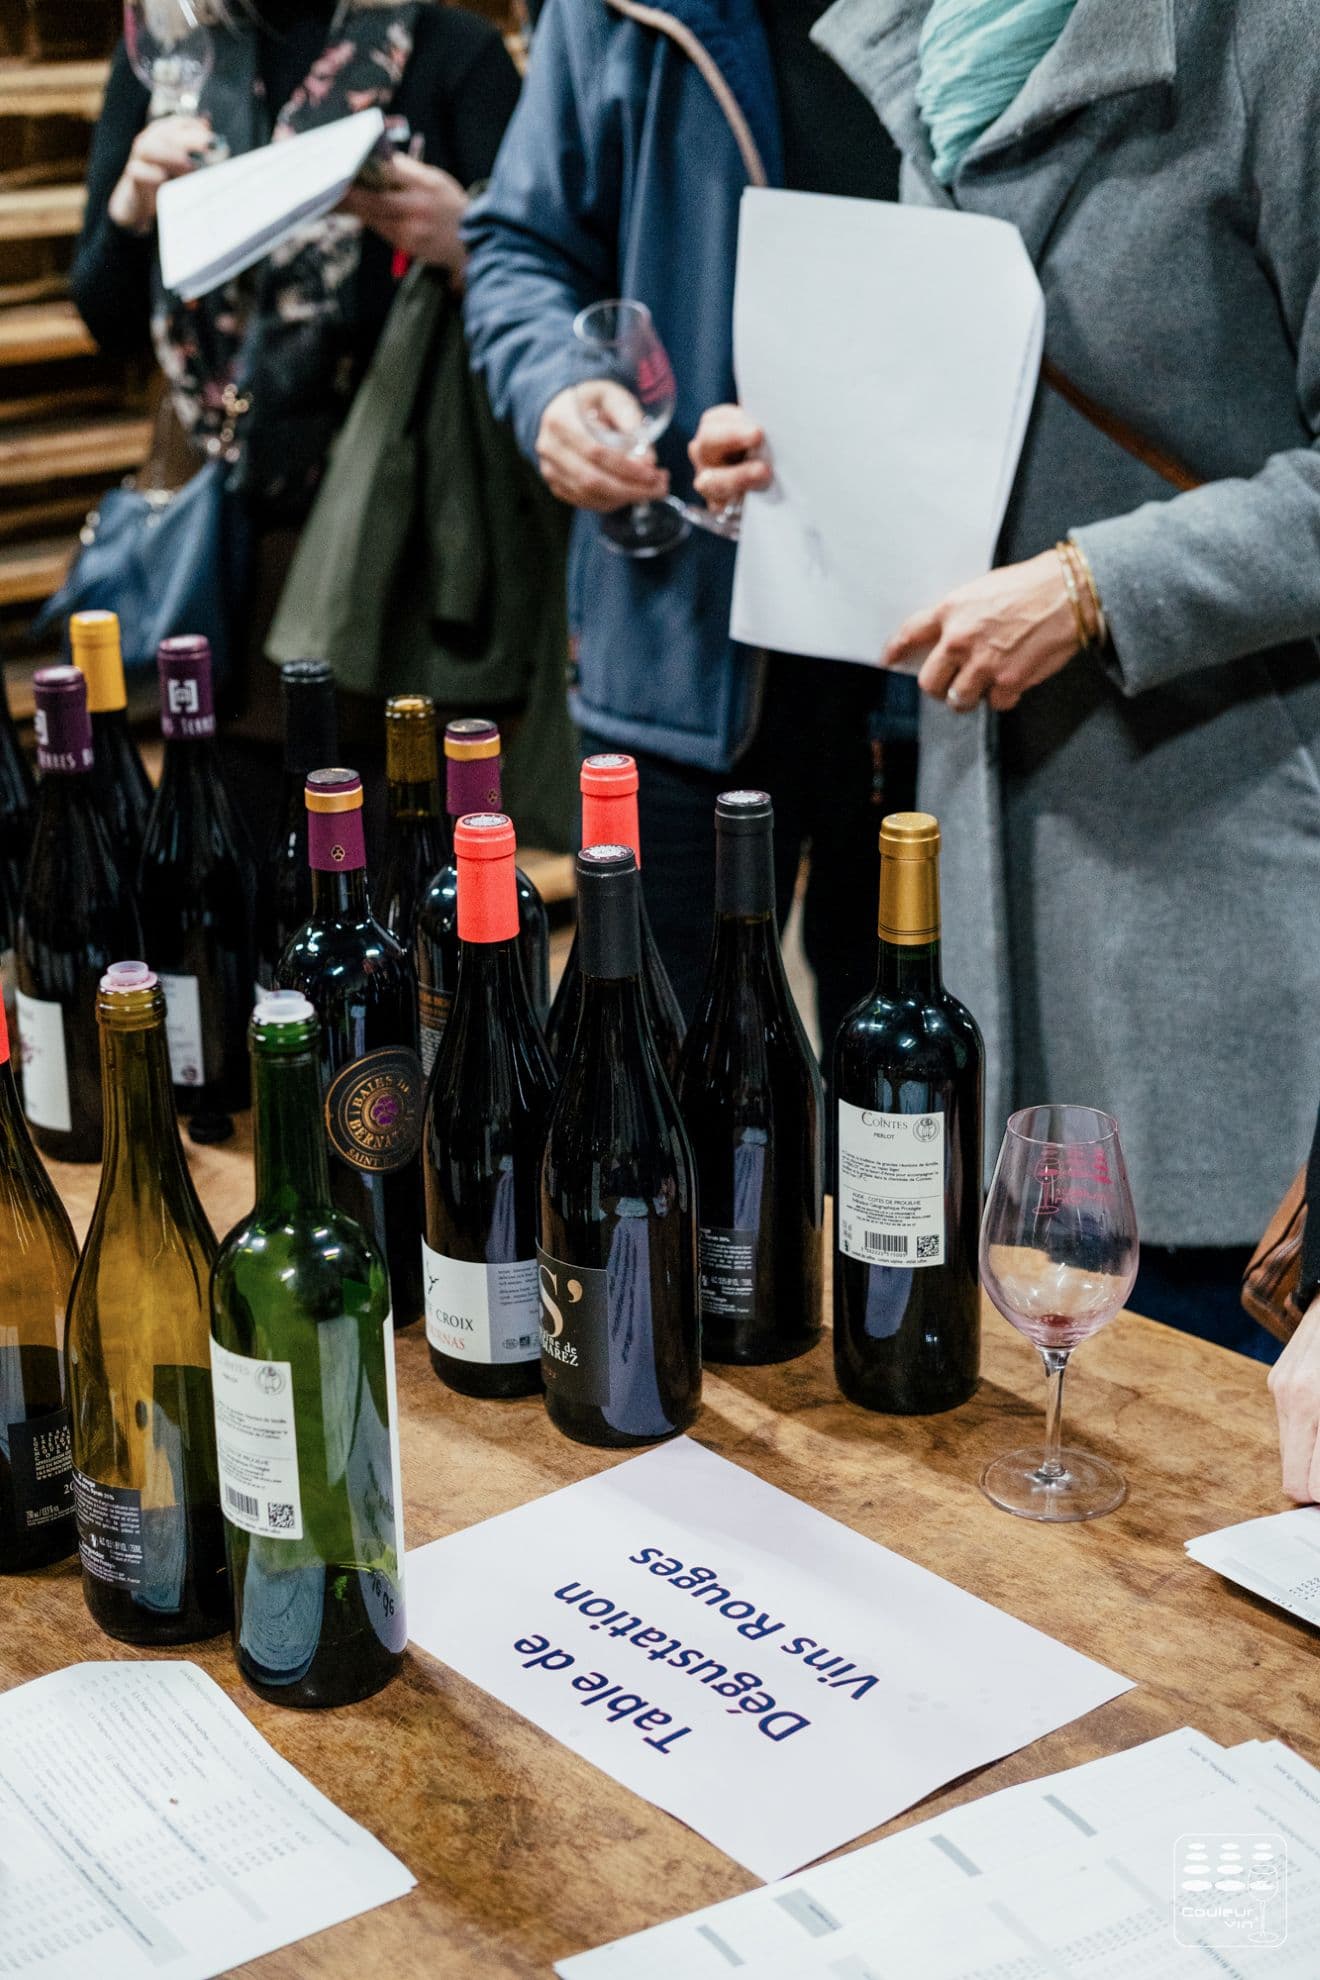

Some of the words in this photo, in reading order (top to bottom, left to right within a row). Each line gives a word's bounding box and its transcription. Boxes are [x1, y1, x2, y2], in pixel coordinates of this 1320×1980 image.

[436, 1309, 474, 1331] CROIX
[564, 1341, 578, 1356] de
[628, 1547, 785, 1641] Rouges
[514, 1633, 575, 1671] de
[554, 1581, 811, 1742] Dégustation
[780, 1636, 879, 1700] Vins
[571, 1671, 693, 1754] Table
